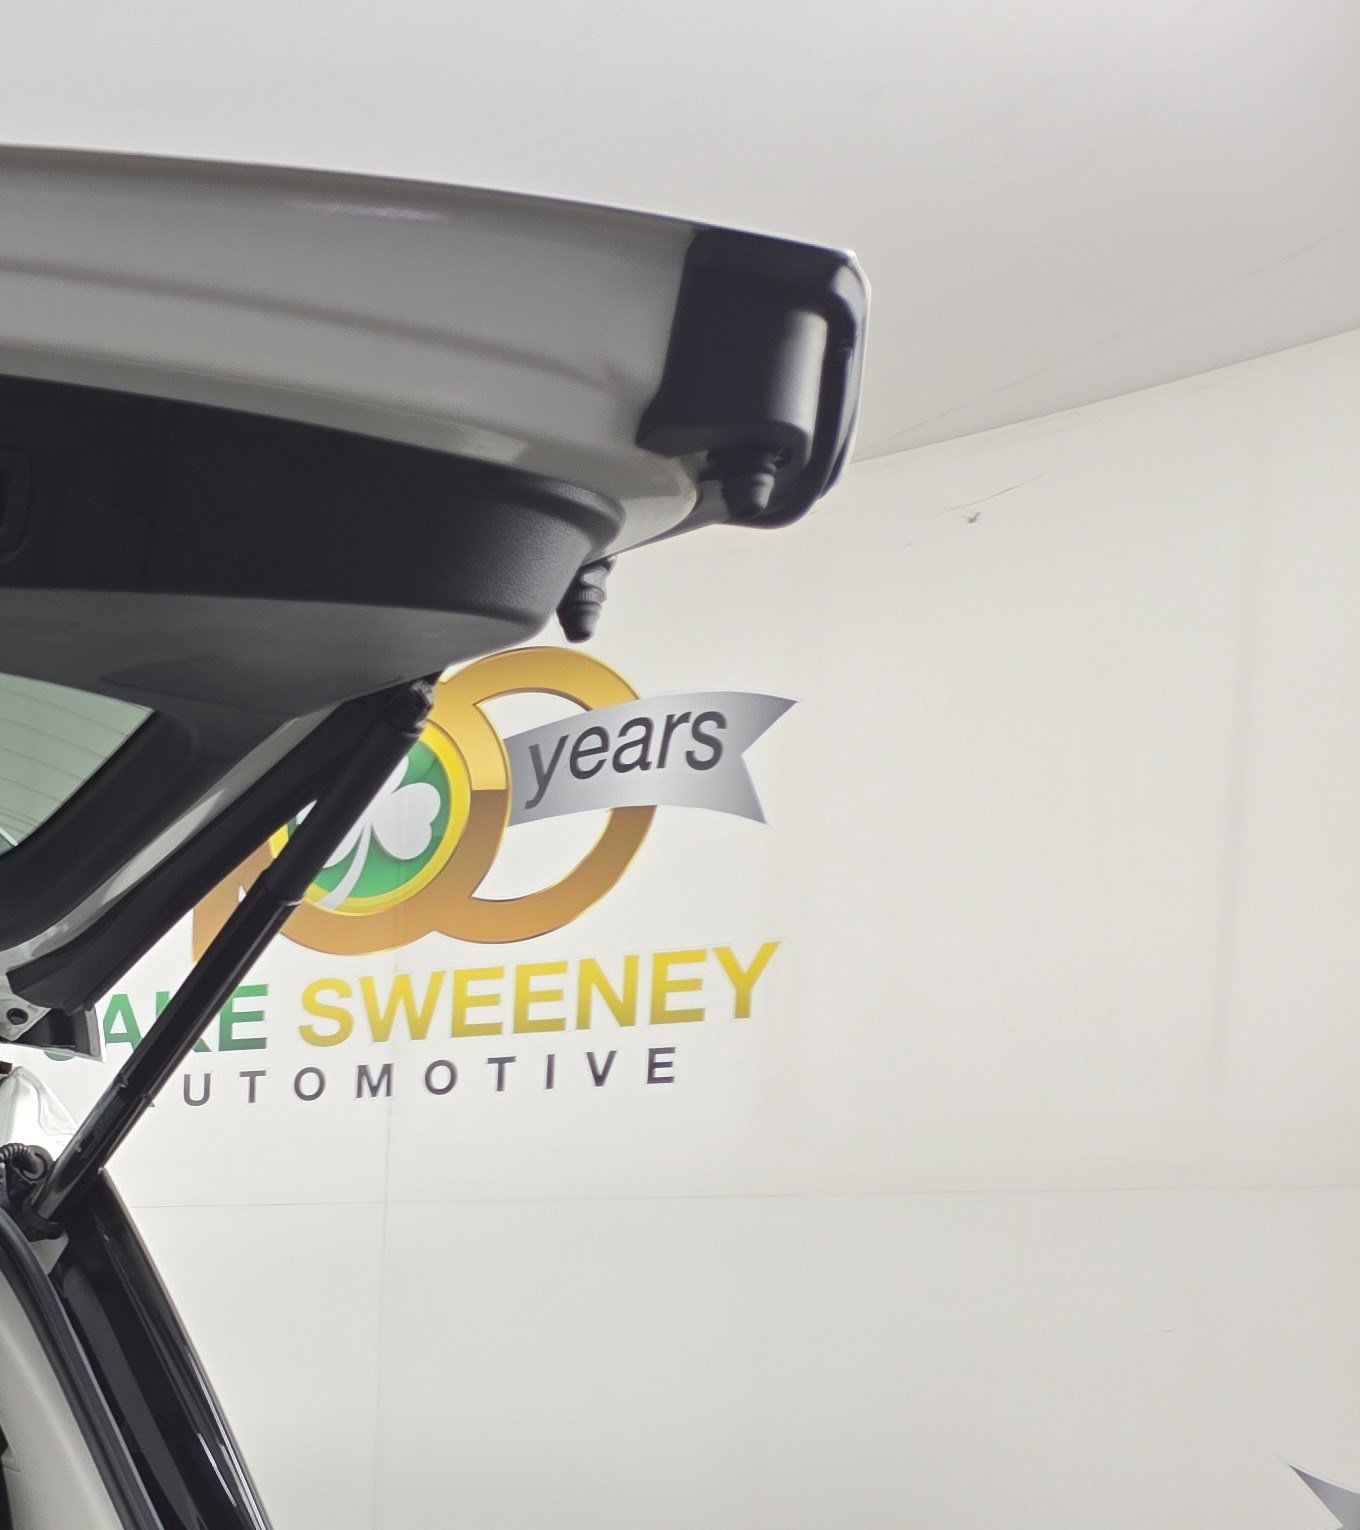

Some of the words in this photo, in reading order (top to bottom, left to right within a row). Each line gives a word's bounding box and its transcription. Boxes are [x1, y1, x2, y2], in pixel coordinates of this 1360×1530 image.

[525, 708, 727, 812] years
[43, 983, 269, 1062] AE
[298, 941, 780, 1048] SWEENEY
[148, 1046, 676, 1108] UTOMOTIVE
